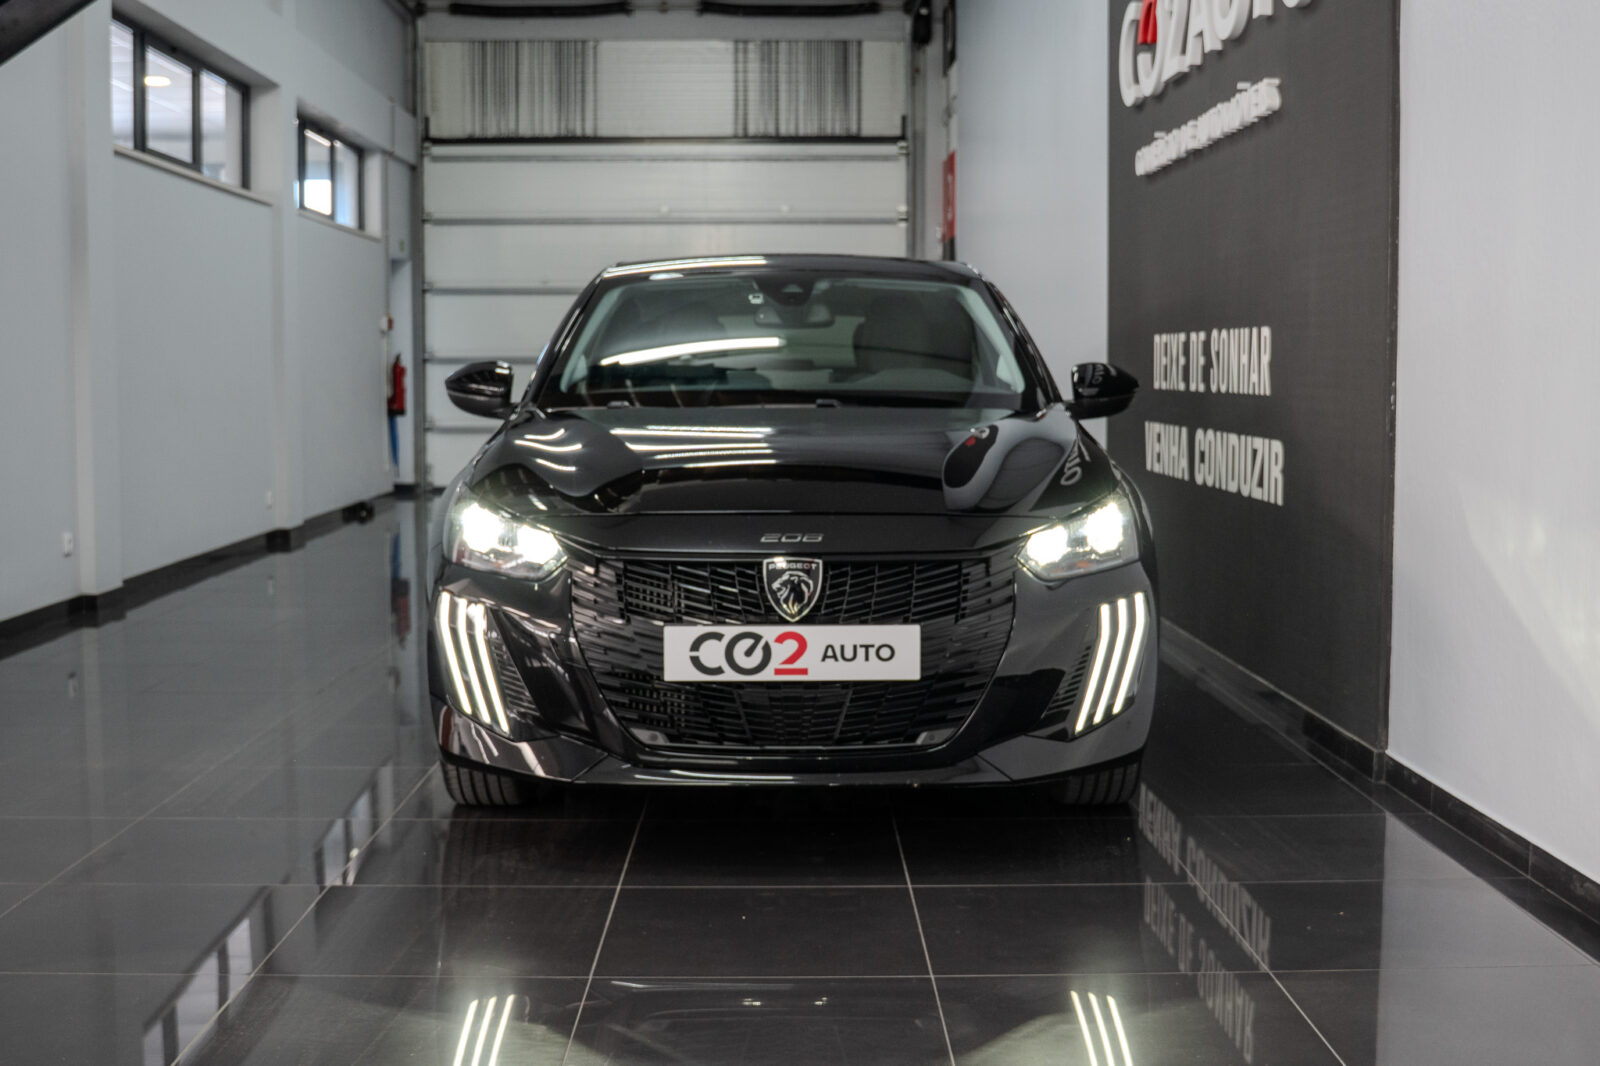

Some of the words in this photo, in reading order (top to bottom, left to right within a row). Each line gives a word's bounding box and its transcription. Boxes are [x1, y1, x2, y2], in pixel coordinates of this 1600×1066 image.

[1153, 332, 1187, 391] DEIXE
[1189, 331, 1207, 392] DE
[1210, 326, 1272, 396] SONHAR
[1145, 420, 1189, 481] VENHA
[1194, 428, 1284, 506] CONDUZIR
[760, 533, 824, 542] 208
[689, 631, 808, 676] CO2
[821, 644, 895, 662] AUTO
